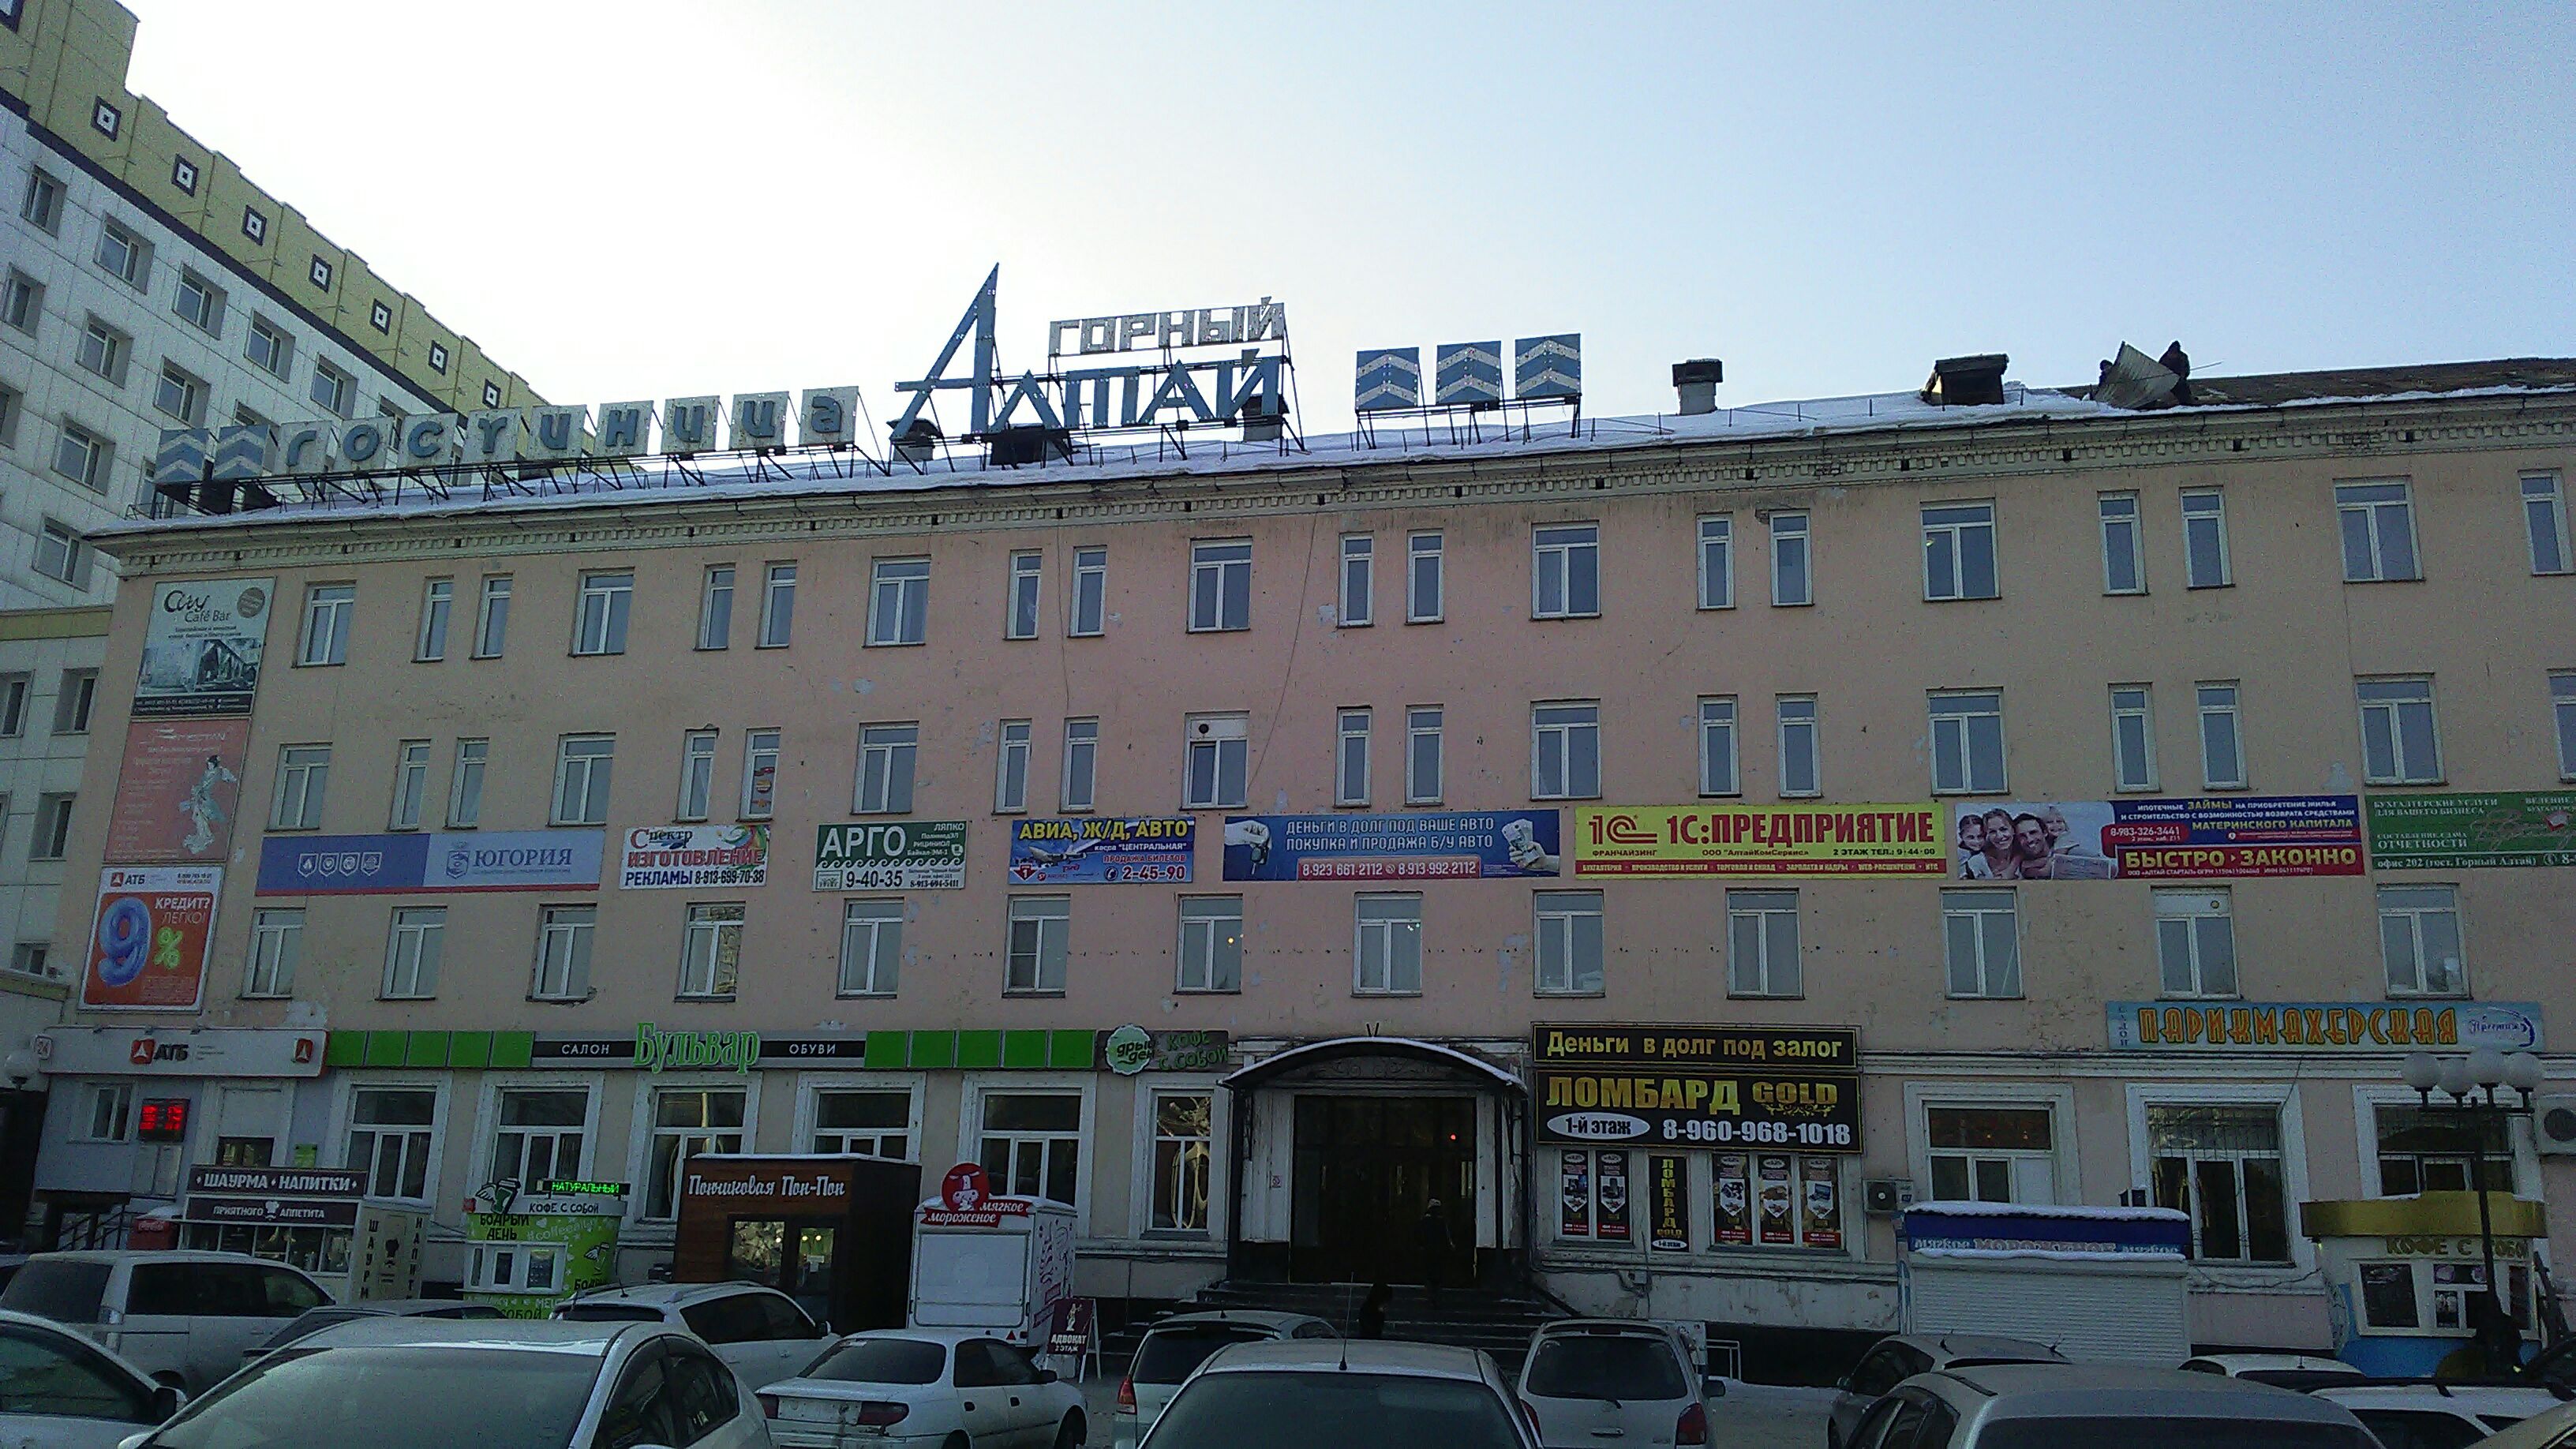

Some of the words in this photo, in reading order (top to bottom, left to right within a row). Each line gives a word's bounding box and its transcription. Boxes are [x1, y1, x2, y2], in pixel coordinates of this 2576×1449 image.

[1050, 297, 1284, 355] ГОРНЫЙ
[890, 263, 1281, 440] АЛТАЙ
[185, 611, 209, 623] Café
[212, 610, 231, 621] Bar
[2188, 799, 2232, 810] ЗАЙМЫ
[2198, 811, 2263, 819] ВОЗМОЖНОСТЬЮ
[934, 822, 964, 831] ЛЯПКО
[1019, 822, 1078, 841] АВИА,
[1135, 820, 1189, 838] АВТО
[1286, 822, 1335, 835] ДЕНЬГИ
[1339, 821, 1347, 833] В
[1350, 820, 1383, 834] ДОЛГ
[1389, 820, 1415, 833] ПОД
[1420, 818, 1456, 831] ВАШЕ
[1459, 818, 1494, 830] АВТО
[1667, 812, 1934, 848] 1С:ПРЕДПРИЯТИЕ
[2192, 819, 2286, 830] МАТЕРИНСКОГО
[2290, 818, 2353, 829] КАПИТАЛА
[631, 829, 693, 849] Спектр
[821, 826, 906, 858] АРГО
[1286, 838, 1346, 850] ПОКУПКА
[1350, 837, 1358, 849] И
[1362, 837, 1427, 851] ПРОДАЖА
[1431, 836, 1455, 850] Б/У
[1458, 835, 1493, 848] АВТО
[2378, 839, 2467, 849] ОТЧЕТНОСТИ
[473, 848, 573, 867] ЮГОРИЯ
[627, 848, 766, 868] ИЗГОТОВЛЕНИЕ
[1103, 855, 1145, 863] ПРОДАЖА
[1147, 854, 1186, 863] БИЛЕТОВ
[2125, 850, 2225, 868] БЫСТРО
[2240, 848, 2357, 867] ЗАКОННО
[2378, 858, 2403, 869] офис
[2406, 858, 2424, 867] 202
[2455, 857, 2496, 868] Горный
[125, 874, 146, 885] АТБ
[625, 870, 693, 886] РЕКЛАМЫ
[846, 870, 903, 888] 9-40-35
[1121, 866, 1186, 881] 2-45-90
[155, 897, 211, 910] КРЕДИТ?
[162, 912, 205, 925] ЛЕГКО!
[98, 897, 152, 987] 9
[2136, 1006, 2458, 1045] ПАРИКМАХЕРСКАЯ
[154, 1043, 189, 1061] АТБ
[561, 1043, 610, 1055] САЛОН
[633, 1022, 761, 1075] Бульвар
[789, 1043, 837, 1055] ОБУВИ
[1547, 1032, 1629, 1056] Деньги
[1644, 1039, 1656, 1054] в
[1662, 1038, 1716, 1058] долг
[1724, 1039, 1766, 1060] под
[1773, 1039, 1842, 1058] залог
[1547, 1076, 1740, 1115] ЛОМБАРД
[1752, 1081, 1838, 1105] GOLD
[1590, 1117, 1632, 1136] этаж
[1663, 1119, 1851, 1146] 8-960-968-1018
[204, 1173, 268, 1189] ШАУРМА
[279, 1174, 350, 1192] НАПИТКИ
[551, 1181, 620, 1194] НАТУРАЛЬНЫЙ
[687, 1174, 776, 1196] Пончиковая
[781, 1174, 846, 1197] Пон-Пон
[1661, 1159, 1676, 1229] ЛОМБАРД
[213, 1205, 264, 1216] ПРИЯТНОГО
[279, 1208, 325, 1219] АППЕТИТА
[529, 1202, 557, 1214] КОФЕ
[560, 1202, 567, 1213] С
[570, 1202, 599, 1215] СОБОЙ
[979, 1201, 1024, 1212] мягкое
[480, 1214, 530, 1226] БОДРЫЙ
[927, 1212, 997, 1226] мороженое
[487, 1227, 518, 1241] ДЕНЬ
[360, 1219, 380, 1299] ШАУРМ
[1050, 1334, 1088, 1345] АДВОКАТ
